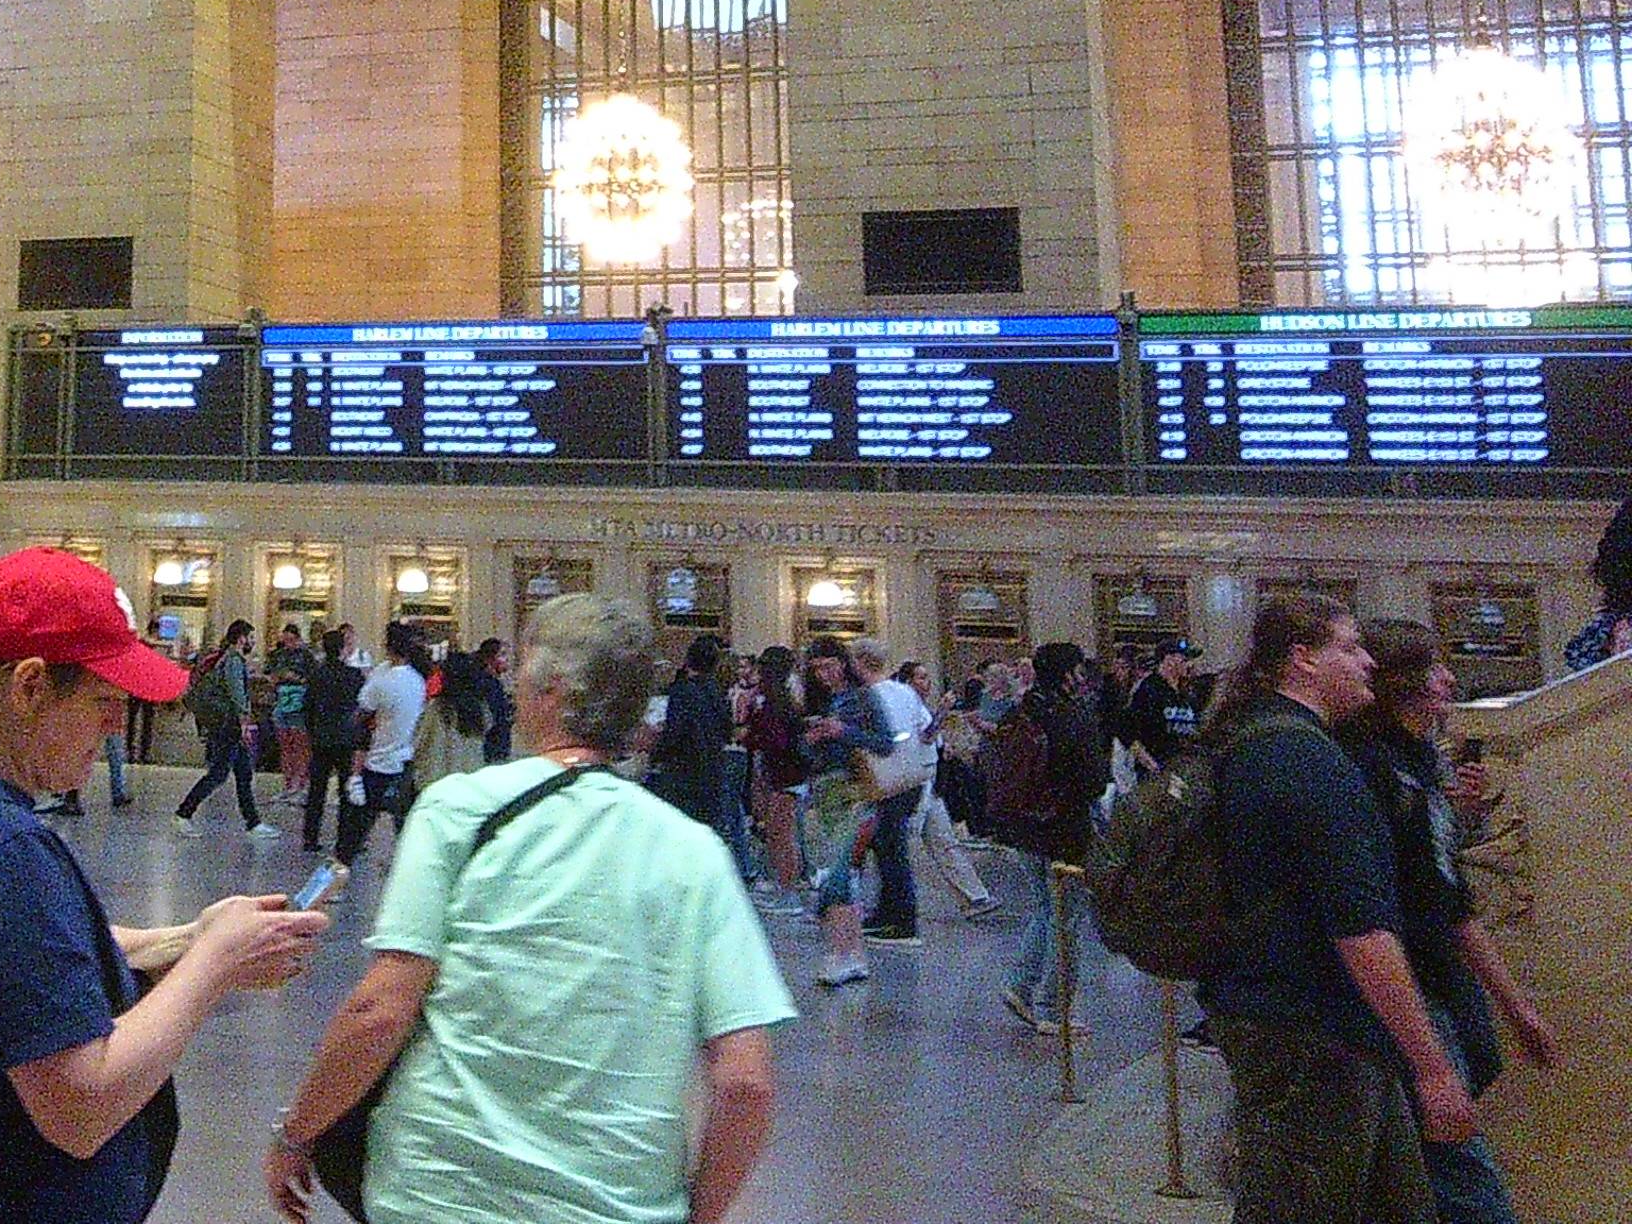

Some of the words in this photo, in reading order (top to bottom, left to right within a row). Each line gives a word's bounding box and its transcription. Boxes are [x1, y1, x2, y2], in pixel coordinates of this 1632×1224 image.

[770, 322, 841, 337] HARLEM
[843, 322, 885, 336] LINE
[887, 320, 1000, 336] DEPARTURES
[1260, 315, 1345, 330] HUDSON
[1348, 314, 1397, 329] LINE
[1399, 311, 1532, 328] DEPARTURES
[352, 328, 413, 341] HARLEM
[414, 327, 450, 341] LINE
[452, 326, 549, 340] DEPARTURES
[832, 523, 936, 544] TICKETS
